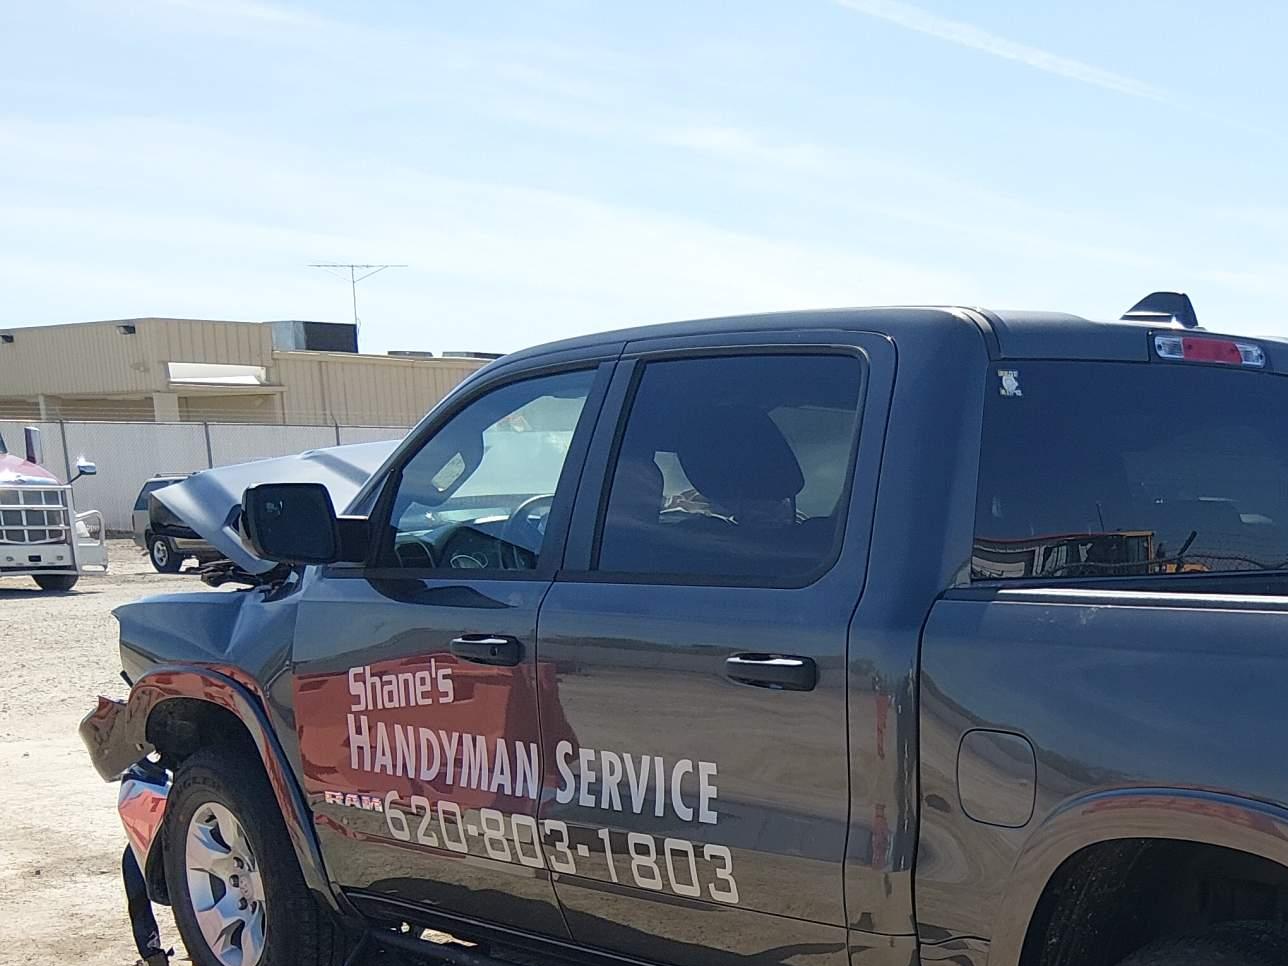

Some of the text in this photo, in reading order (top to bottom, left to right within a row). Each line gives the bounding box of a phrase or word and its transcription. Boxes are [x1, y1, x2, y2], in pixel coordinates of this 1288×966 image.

[348, 658, 454, 712] Shane's
[324, 790, 383, 813] RAM
[347, 713, 718, 825] HANDYMAN SERVICE
[383, 790, 739, 904] 620-803-1803
